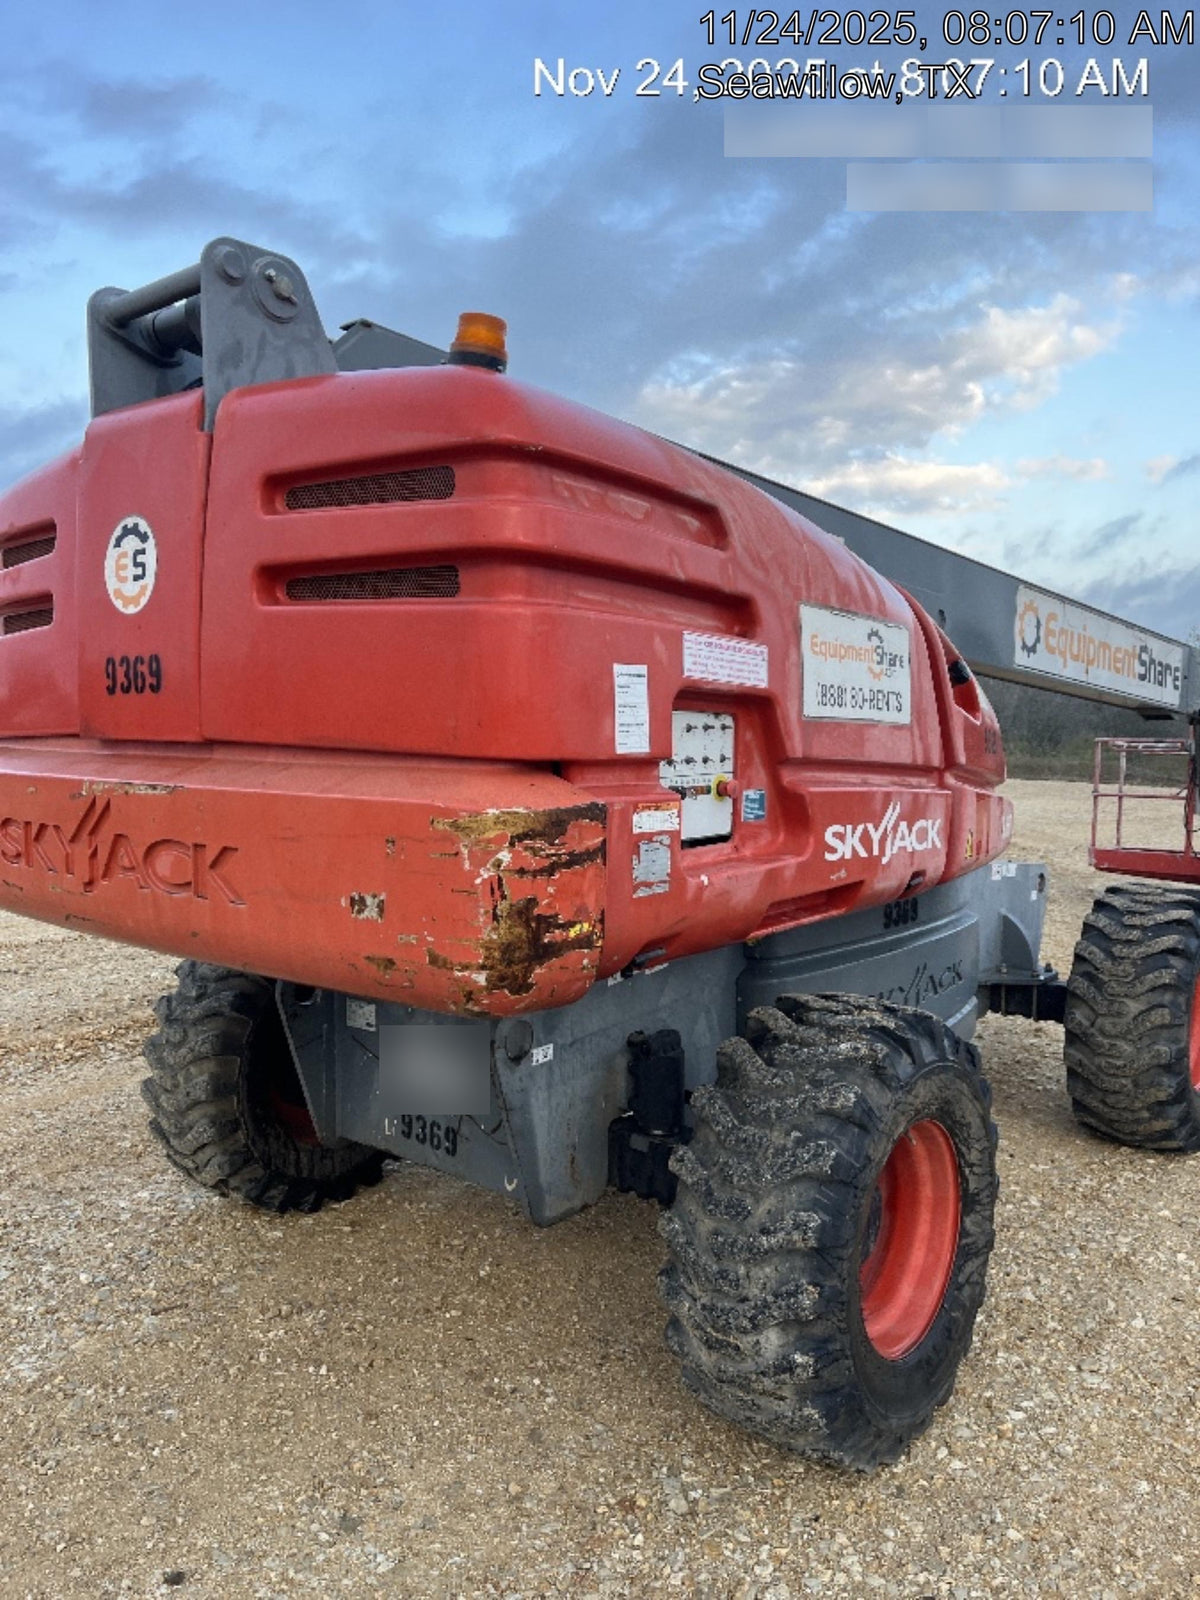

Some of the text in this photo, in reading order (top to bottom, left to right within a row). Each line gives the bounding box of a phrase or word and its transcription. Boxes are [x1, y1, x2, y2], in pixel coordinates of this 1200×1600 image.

[105, 653, 162, 696] 9369
[0, 796, 247, 906] SKYJACK
[824, 801, 942, 864] SKYJACK
[401, 1114, 458, 1157] 9369
